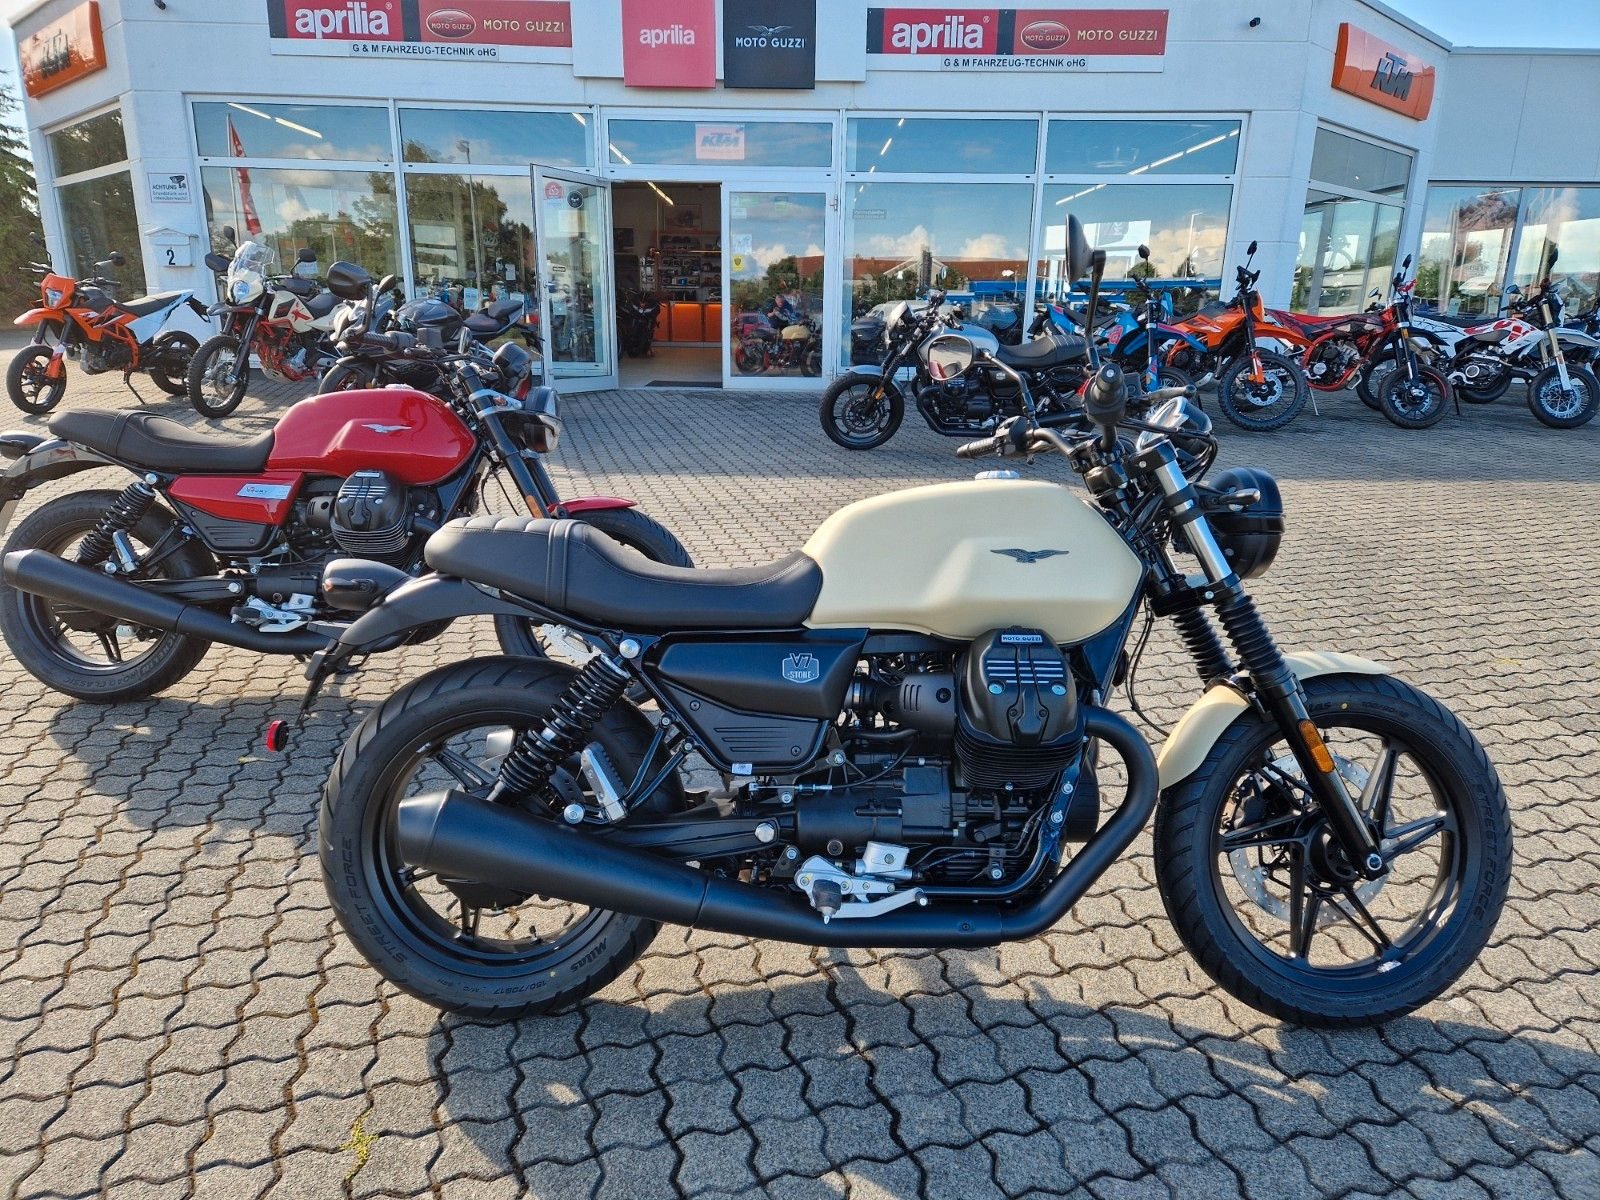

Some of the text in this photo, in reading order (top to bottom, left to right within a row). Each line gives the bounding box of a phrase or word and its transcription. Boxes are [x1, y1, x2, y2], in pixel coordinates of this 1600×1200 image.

[295, 2, 390, 39] aprilia
[431, 22, 472, 31] MOTO GUZZI
[483, 19, 565, 33] MOTO GUZZI
[639, 24, 695, 48] aprilia
[891, 15, 984, 54] aprilia
[1077, 30, 1158, 41] MOTO GUZZI
[352, 44, 497, 57] G & M FAHRZEUG-TECHNIK oHG
[735, 37, 806, 49] MOTO GUZZI
[944, 58, 1086, 67] G & M FAHRZEUG-TECHNIK oHG
[1371, 52, 1414, 101] KTM
[166, 249, 176, 266] 2
[789, 652, 813, 668] V7
[790, 670, 812, 679] STONE
[342, 837, 409, 964] STREET FORCE
[570, 937, 608, 972] Mitas
